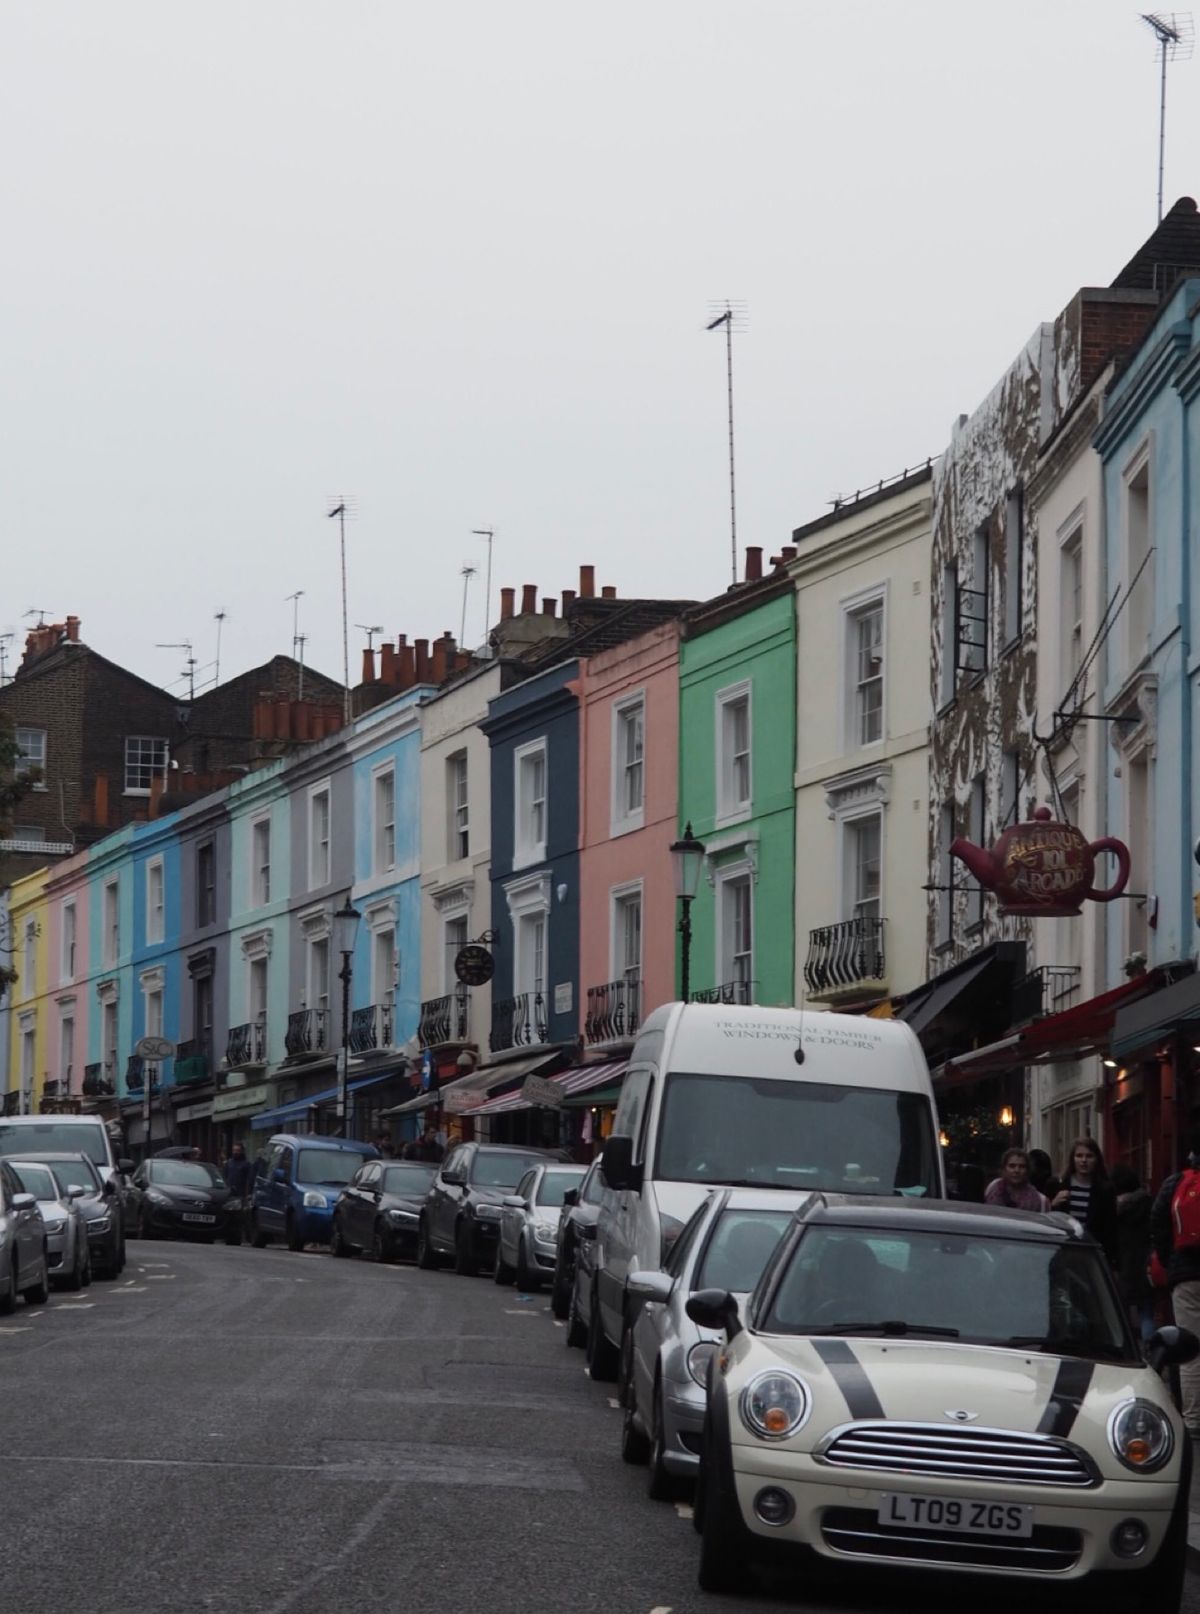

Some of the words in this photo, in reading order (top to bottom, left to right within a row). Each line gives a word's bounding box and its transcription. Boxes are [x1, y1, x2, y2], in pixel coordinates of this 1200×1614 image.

[715, 1021, 818, 1035] TRADITIONAL
[822, 1030, 882, 1043] TIMBER
[723, 1030, 801, 1042] WINDOWS
[805, 1036, 816, 1044] &
[820, 1037, 875, 1050] DOORS
[890, 1496, 962, 1526] LT09
[969, 1503, 1022, 1531] ZGS
